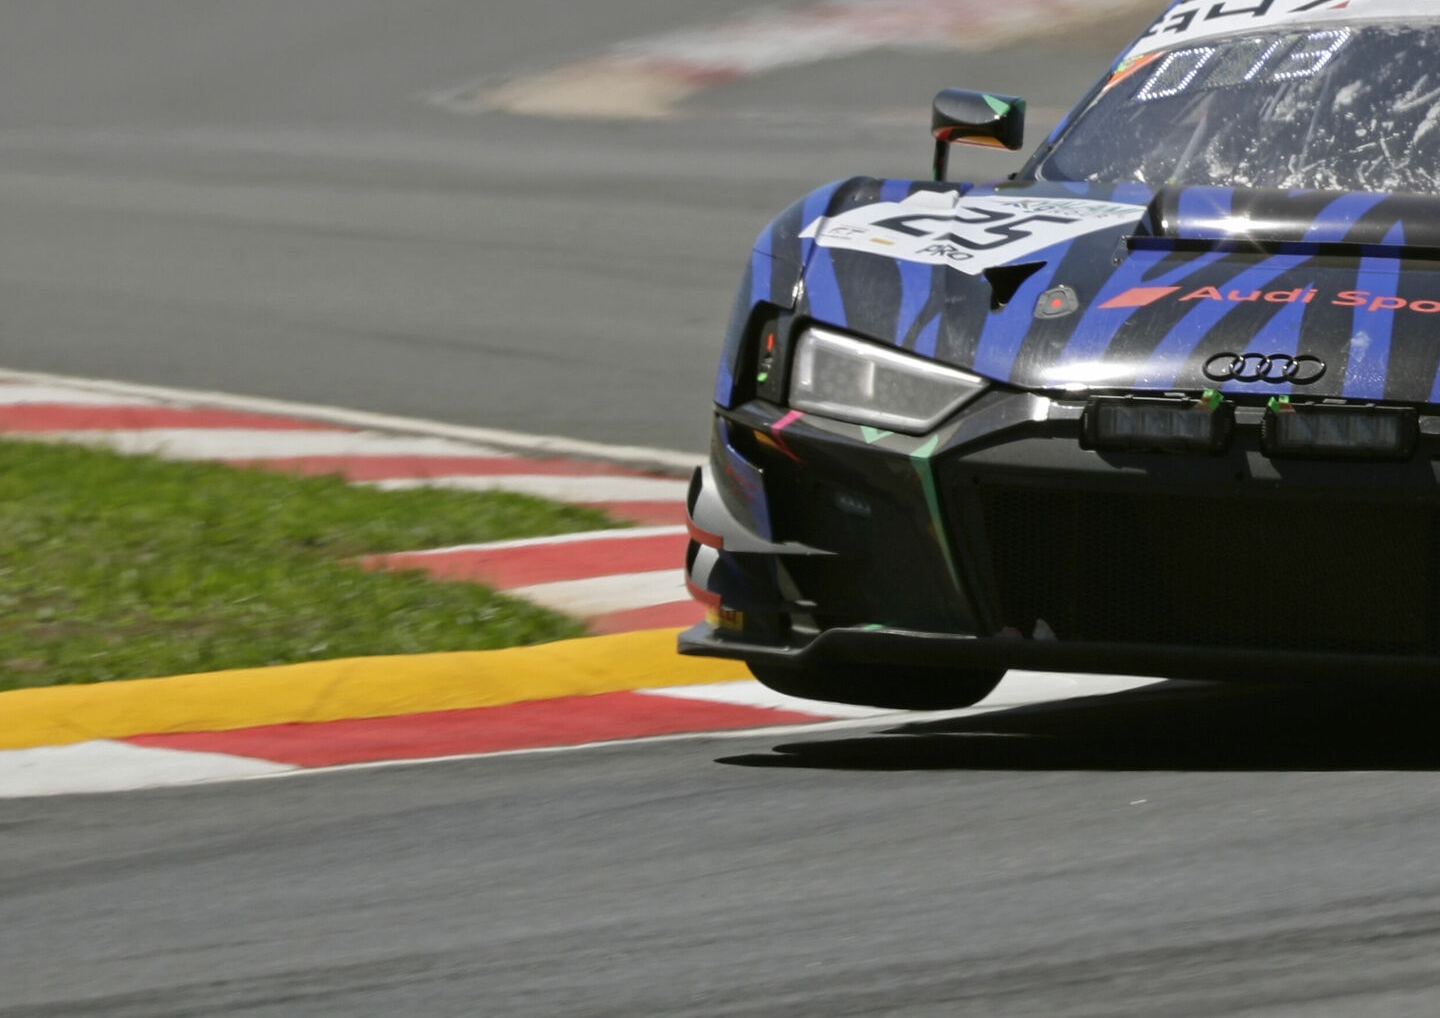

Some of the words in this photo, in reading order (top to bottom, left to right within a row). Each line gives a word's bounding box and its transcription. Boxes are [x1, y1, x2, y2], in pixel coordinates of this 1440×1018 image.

[871, 207, 1085, 251] 25
[914, 243, 974, 262] PRO
[1178, 286, 1318, 304] Audi
